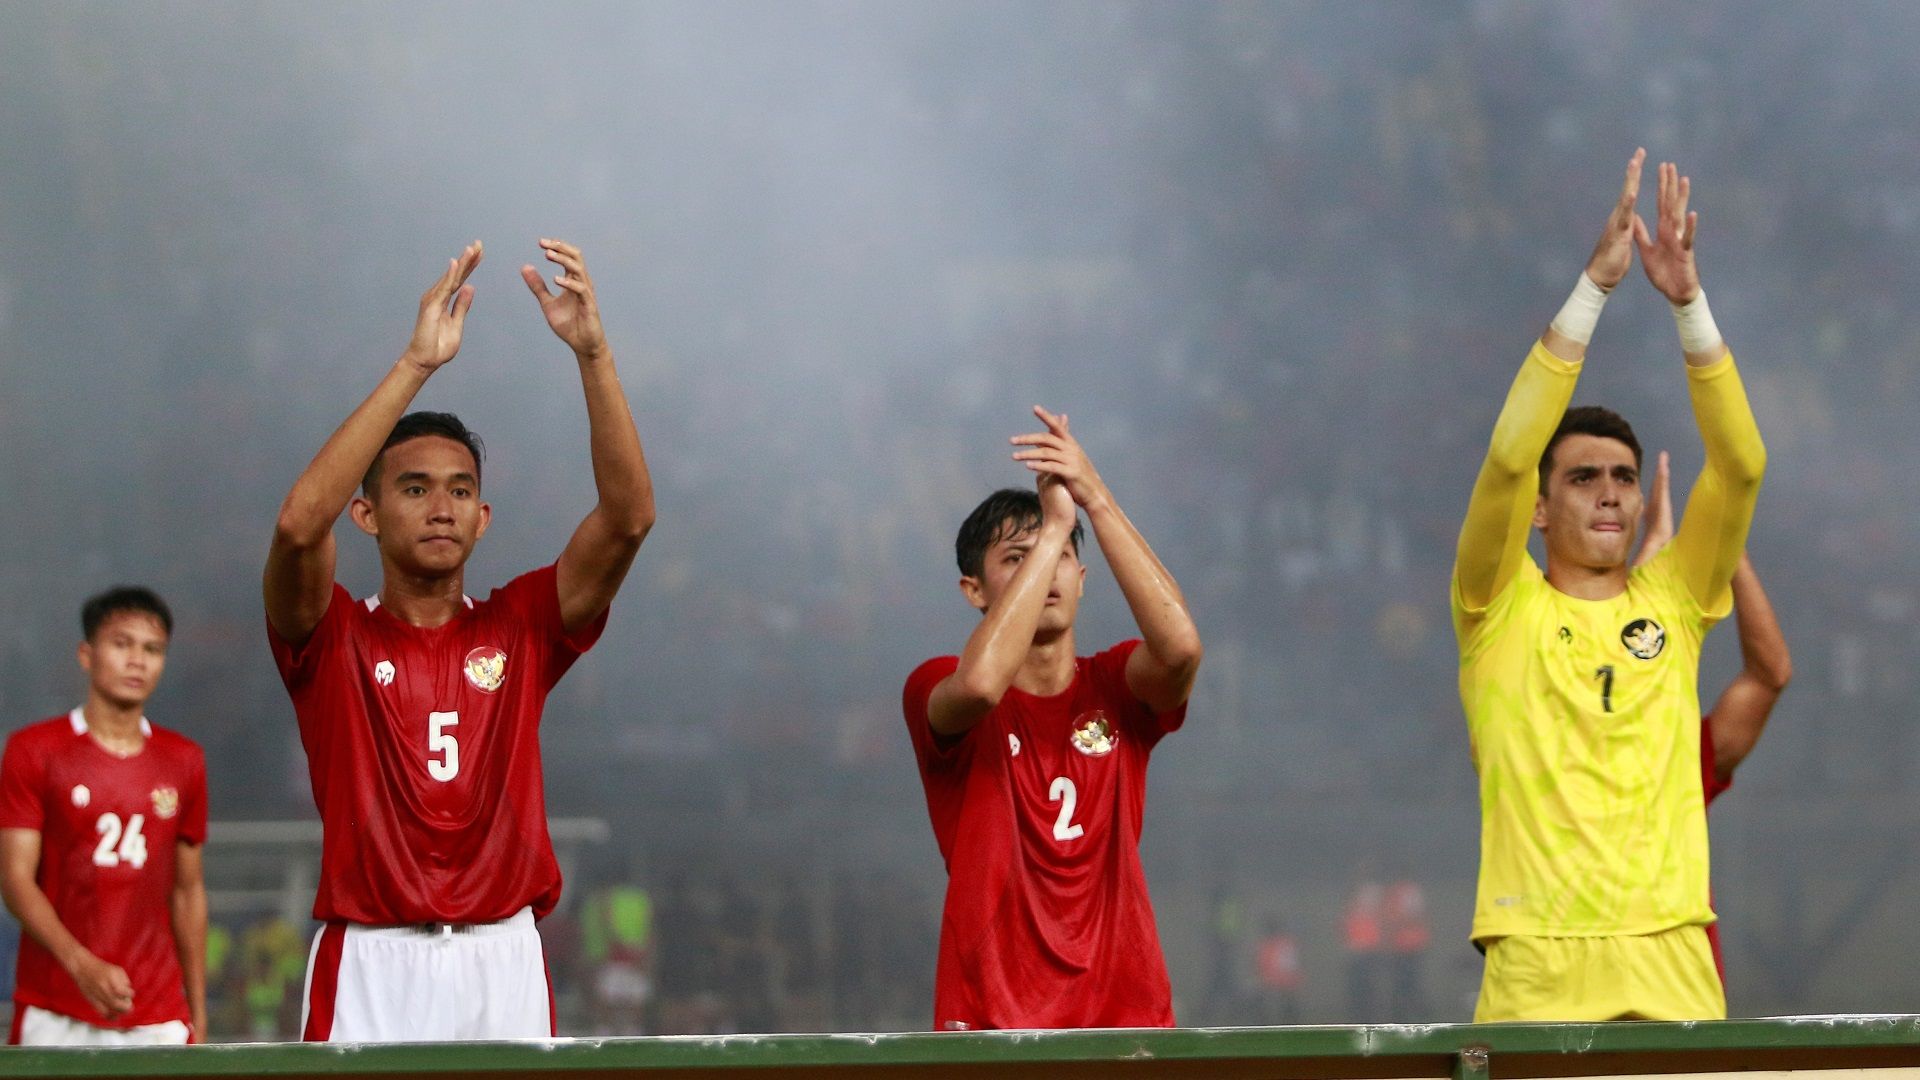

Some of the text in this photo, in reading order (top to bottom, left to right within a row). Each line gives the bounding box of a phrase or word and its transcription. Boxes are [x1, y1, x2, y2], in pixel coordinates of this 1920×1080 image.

[1594, 665, 1614, 713] 1
[428, 711, 459, 782] 5
[1049, 776, 1084, 841] 2
[92, 811, 148, 869] 24
